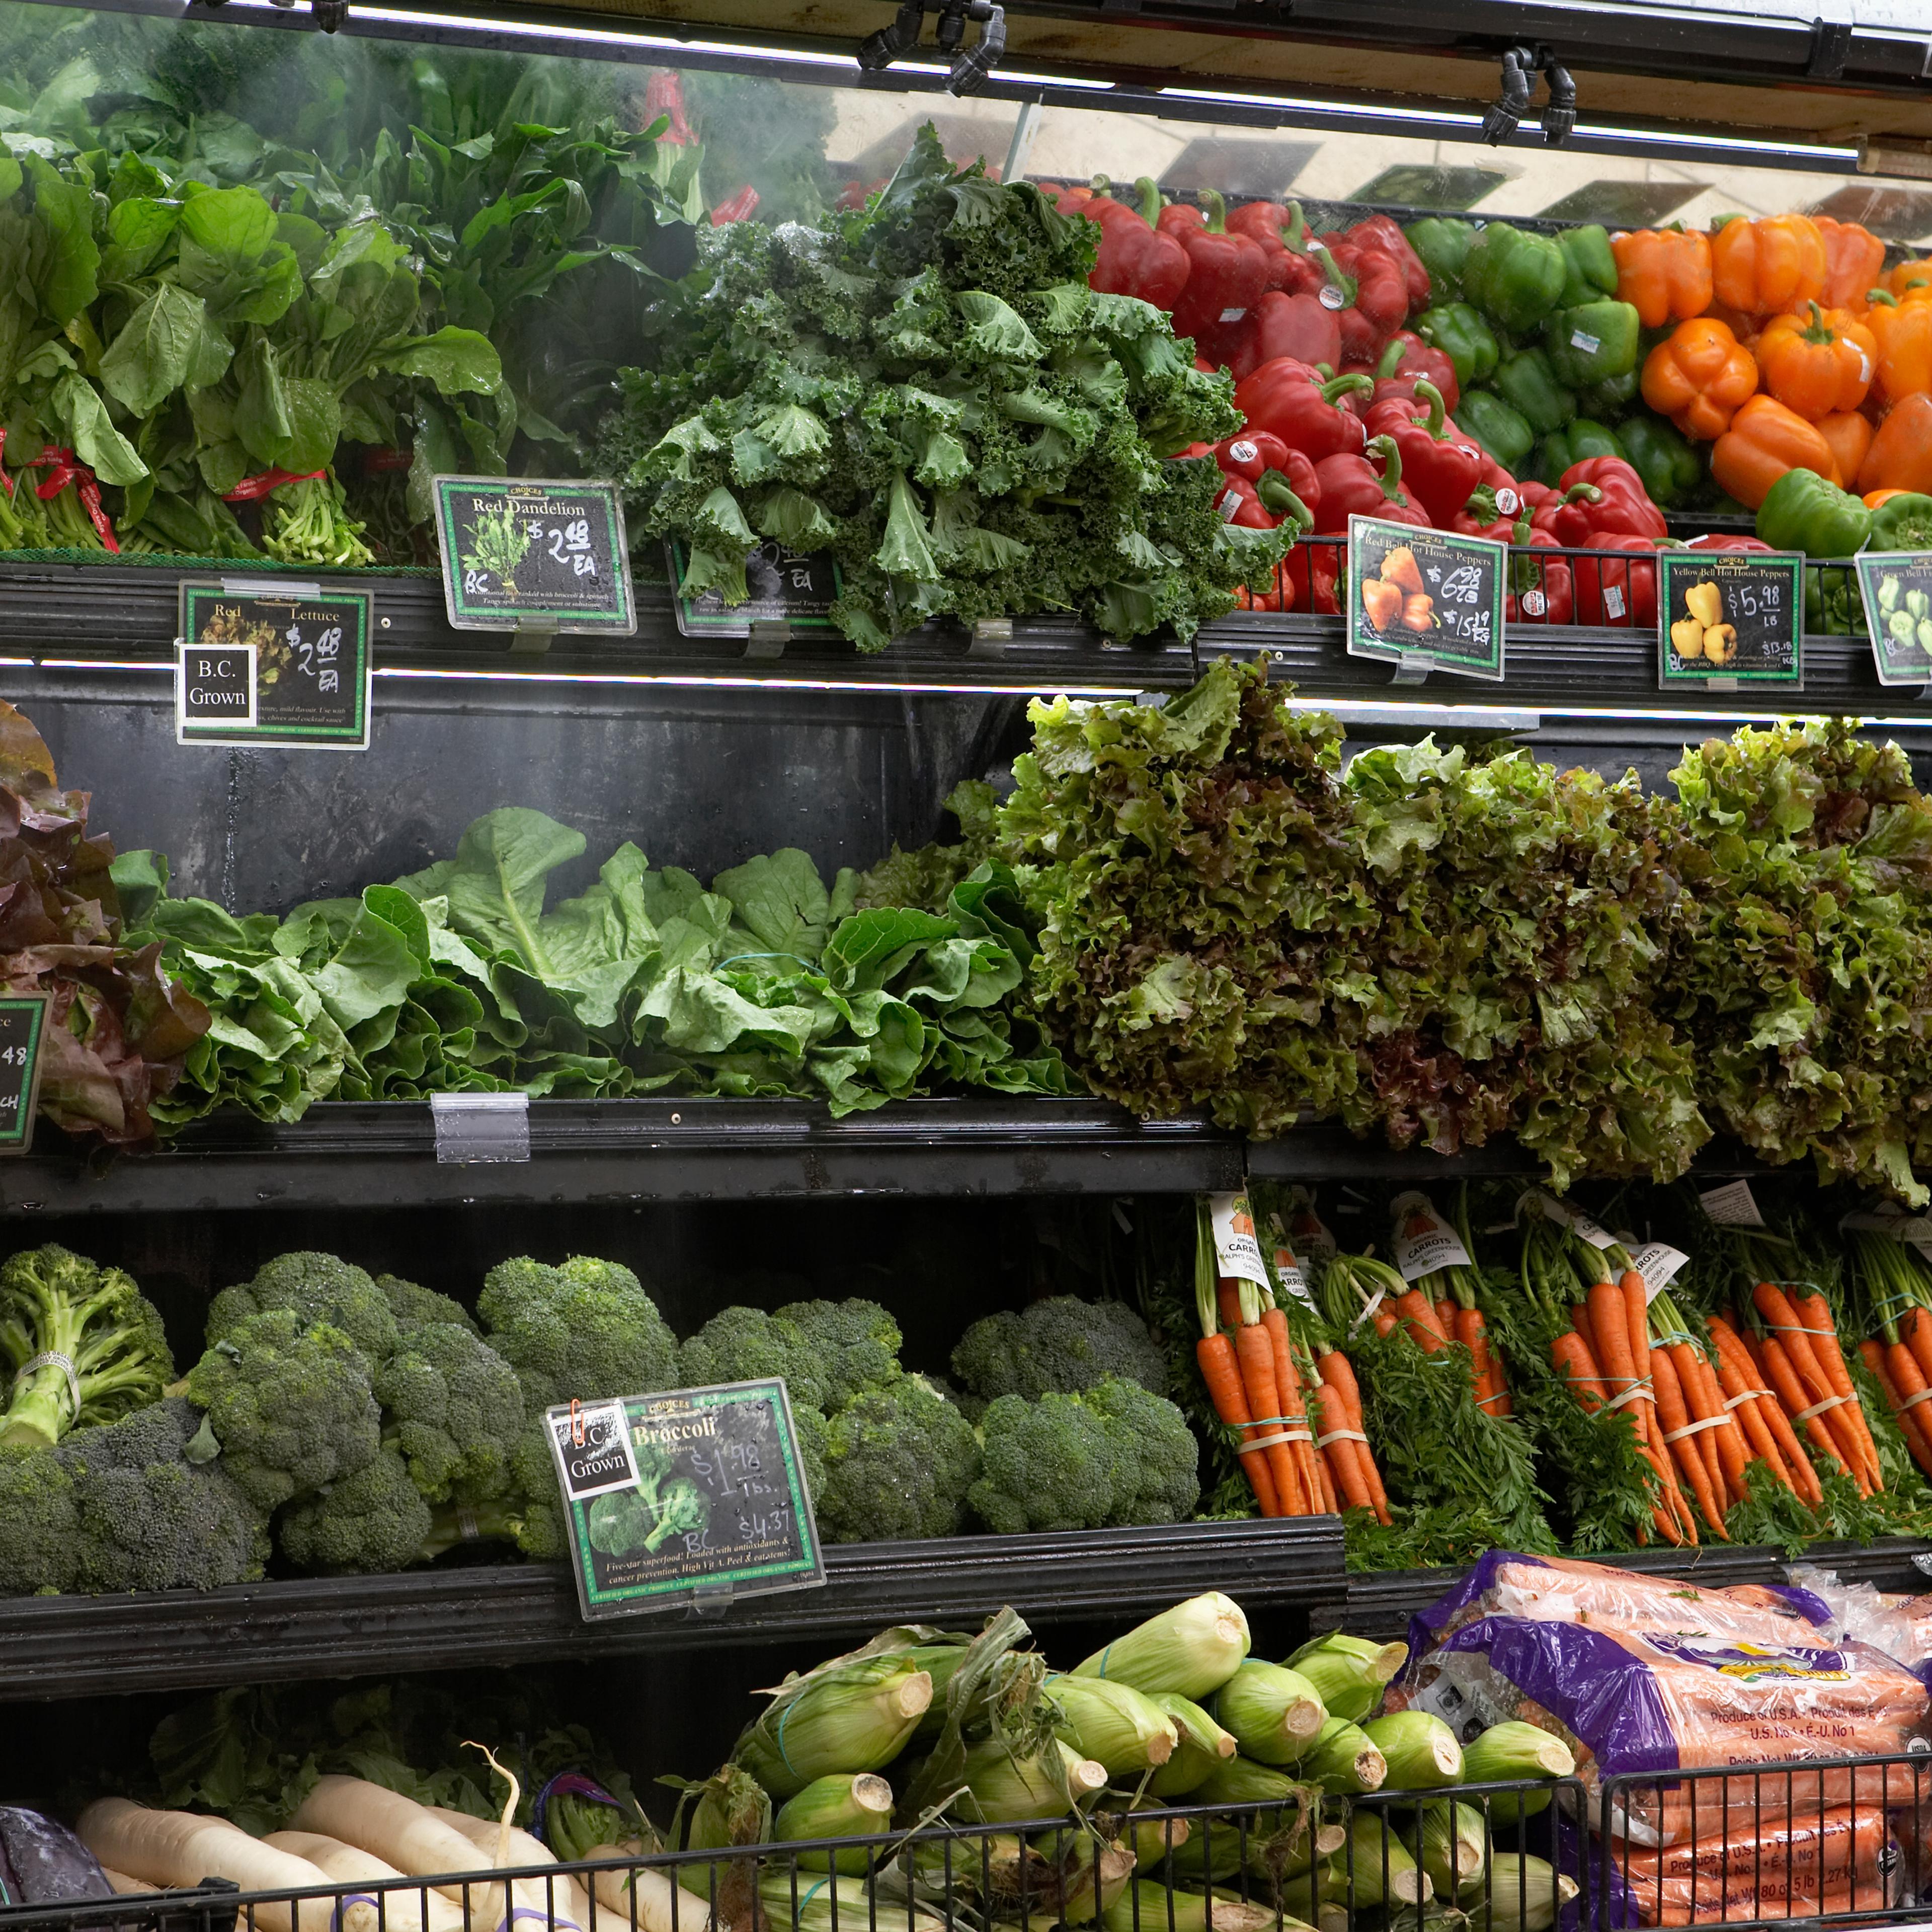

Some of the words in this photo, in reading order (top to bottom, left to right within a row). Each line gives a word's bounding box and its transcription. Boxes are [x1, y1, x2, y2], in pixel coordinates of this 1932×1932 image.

[472, 498, 503, 512] Red
[506, 500, 585, 516] Dandelion
[1365, 536, 1383, 546] Red
[1385, 539, 1403, 549] Bell
[1424, 546, 1454, 560] House
[1456, 552, 1492, 567] Peppers
[1718, 556, 1744, 565] CHOICES
[573, 554, 596, 576] EA
[1672, 568, 1699, 577] Yellow
[1701, 568, 1716, 577] Bell
[1717, 569, 1733, 577] Hot
[1734, 569, 1758, 578] House
[1760, 570, 1790, 579] Peppers
[1905, 569, 1922, 578] Bell
[464, 570, 489, 594] BC
[215, 604, 241, 617] Red
[290, 608, 340, 621] Lettuce
[1763, 616, 1778, 627] LB
[198, 660, 236, 678] B.C.
[1668, 653, 1686, 672] BC
[318, 669, 339, 693] EA
[189, 687, 246, 705] Grown
[1408, 1238, 1452, 1258] CARROTS
[1642, 1250, 1672, 1276] GREENHOUSE
[1647, 1266, 1665, 1286] 94094
[649, 1400, 690, 1414] CHOICES
[632, 1416, 716, 1446] Broccoli
[571, 1454, 626, 1478] Grown
[575, 1500, 586, 1540] RGANIC
[682, 1527, 718, 1553] BC
[606, 1560, 641, 1572] Five-star
[642, 1552, 684, 1566] superfood!
[716, 1545, 732, 1555] with
[734, 1539, 780, 1552] antioxidants
[782, 1536, 789, 1545] &
[609, 1573, 635, 1584] cancer
[636, 1568, 679, 1582] prevention.
[682, 1564, 701, 1573] High
[727, 1556, 743, 1566] Peel
[767, 1548, 790, 1560] stems!
[1711, 1712, 1756, 1724] Produce
[1769, 1710, 1801, 1721] U.S.A.
[1750, 1728, 1773, 1740] U.S.
[1806, 1723, 1831, 1738] É.-U.
[1832, 1725, 1846, 1737] No
[1850, 1725, 1855, 1737] 1
[1670, 1854, 1717, 1873] Prouce
[1733, 1844, 1765, 1859] U.S..
[1761, 1886, 1775, 1898] 80
[1794, 1878, 1800, 1891] 5
[1804, 1876, 1814, 1889] lb
